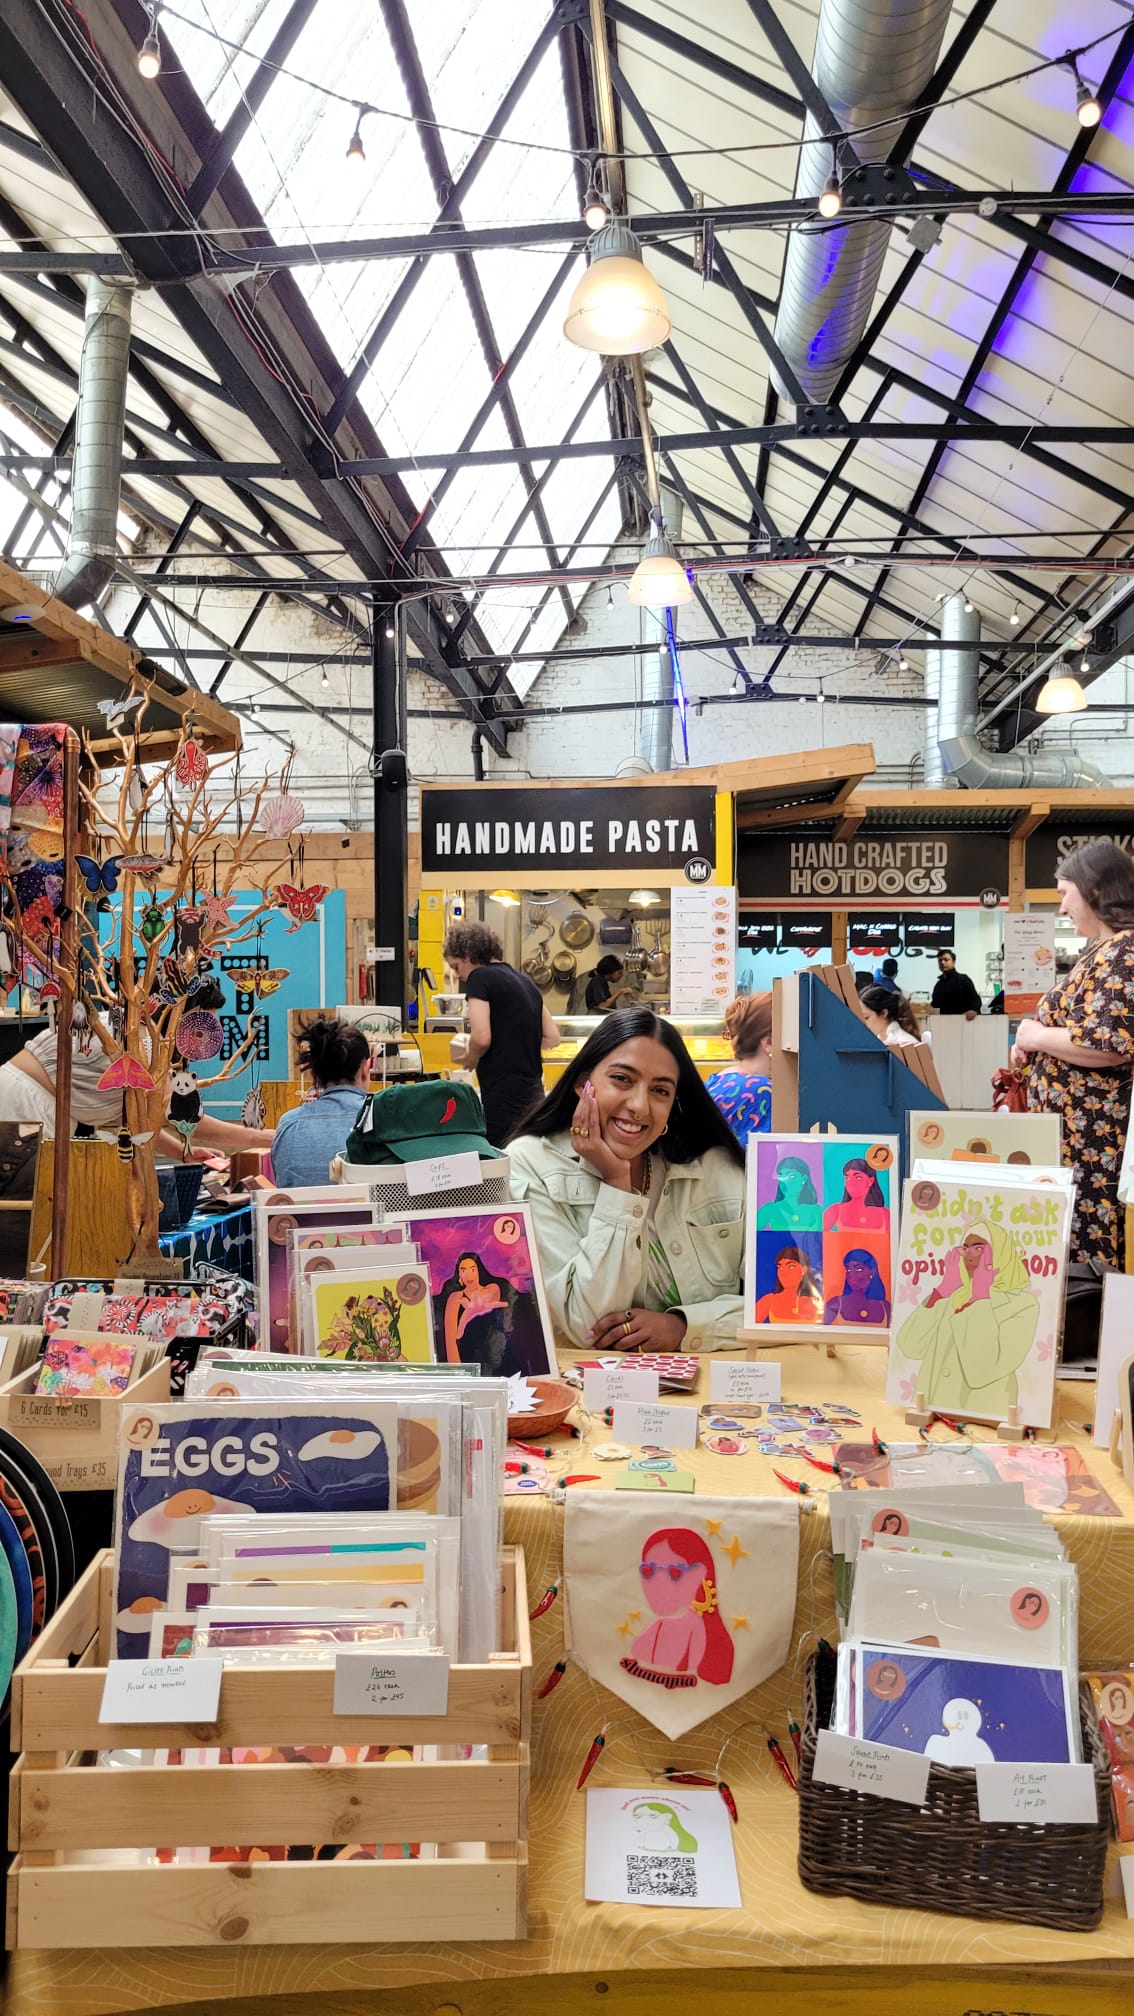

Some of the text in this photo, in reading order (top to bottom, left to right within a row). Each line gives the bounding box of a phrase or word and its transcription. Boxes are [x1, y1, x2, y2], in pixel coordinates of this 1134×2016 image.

[436, 819, 699, 854] HANDMADE PASTA
[790, 841, 948, 868] HAND CRAFTED
[790, 868, 948, 894] HOTDOGS
[924, 1188, 1004, 1223] idn't
[1009, 1199, 1060, 1227] ask
[911, 1222, 963, 1257] for
[20, 1401, 26, 1415] 6
[30, 1402, 52, 1416] Cards
[74, 1404, 88, 1417] £15
[141, 1432, 280, 1477] EGGS
[66, 1463, 88, 1480] Trays
[92, 1463, 107, 1476] £35
[371, 1666, 396, 1679] Posters
[371, 1695, 378, 1703] 2
